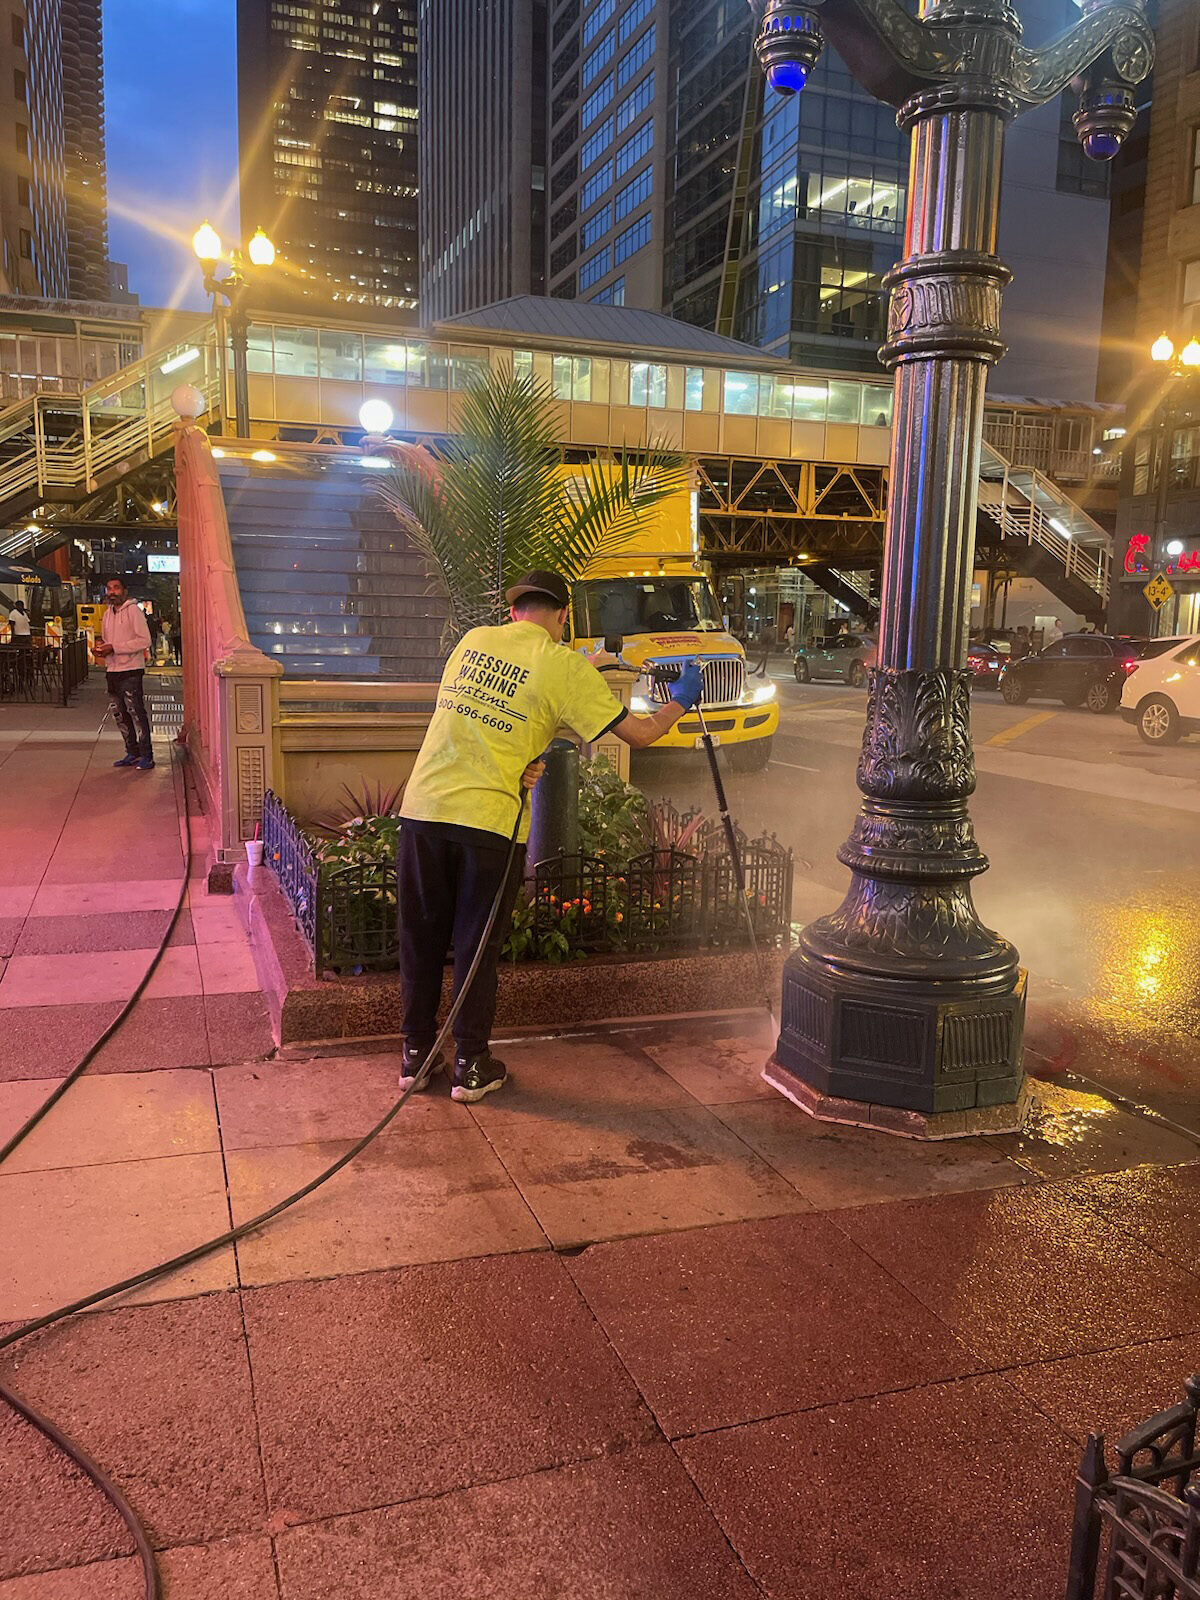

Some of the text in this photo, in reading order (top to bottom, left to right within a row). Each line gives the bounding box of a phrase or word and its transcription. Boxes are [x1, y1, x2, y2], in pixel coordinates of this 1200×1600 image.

[459, 664, 518, 698] WASHING
[461, 648, 530, 685] PRESSURE
[447, 676, 509, 710] Systems
